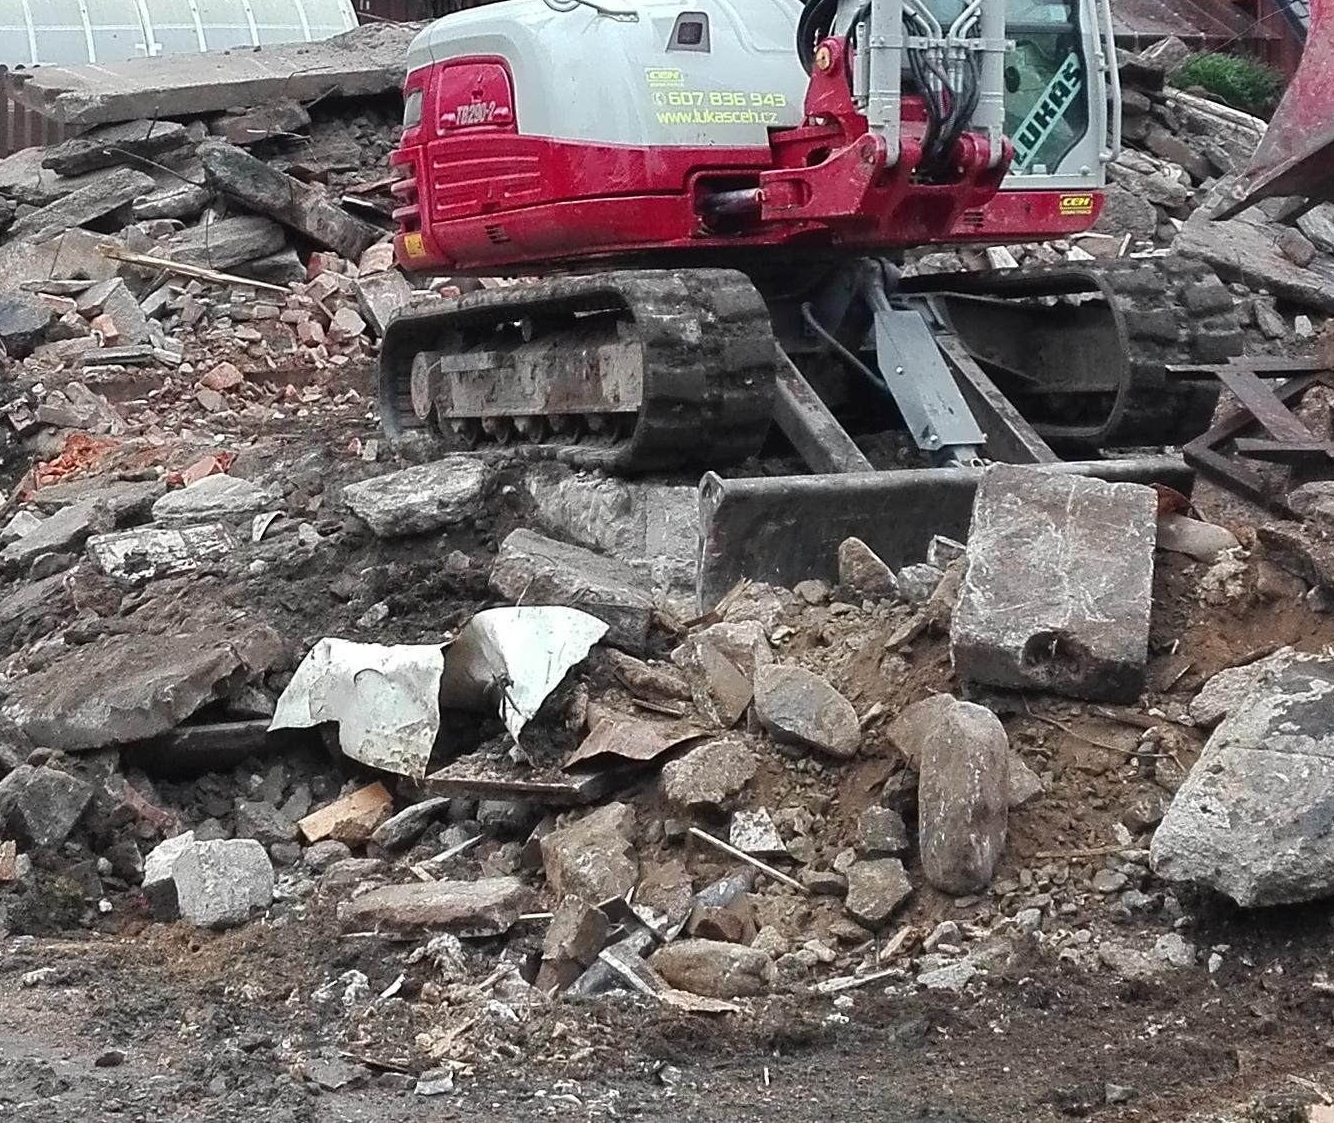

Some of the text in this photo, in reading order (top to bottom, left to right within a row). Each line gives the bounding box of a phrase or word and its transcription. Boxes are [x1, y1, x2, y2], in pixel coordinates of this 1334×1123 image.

[668, 92, 786, 107] 607 836 943
[657, 108, 778, 124] www.lukasceh.cz
